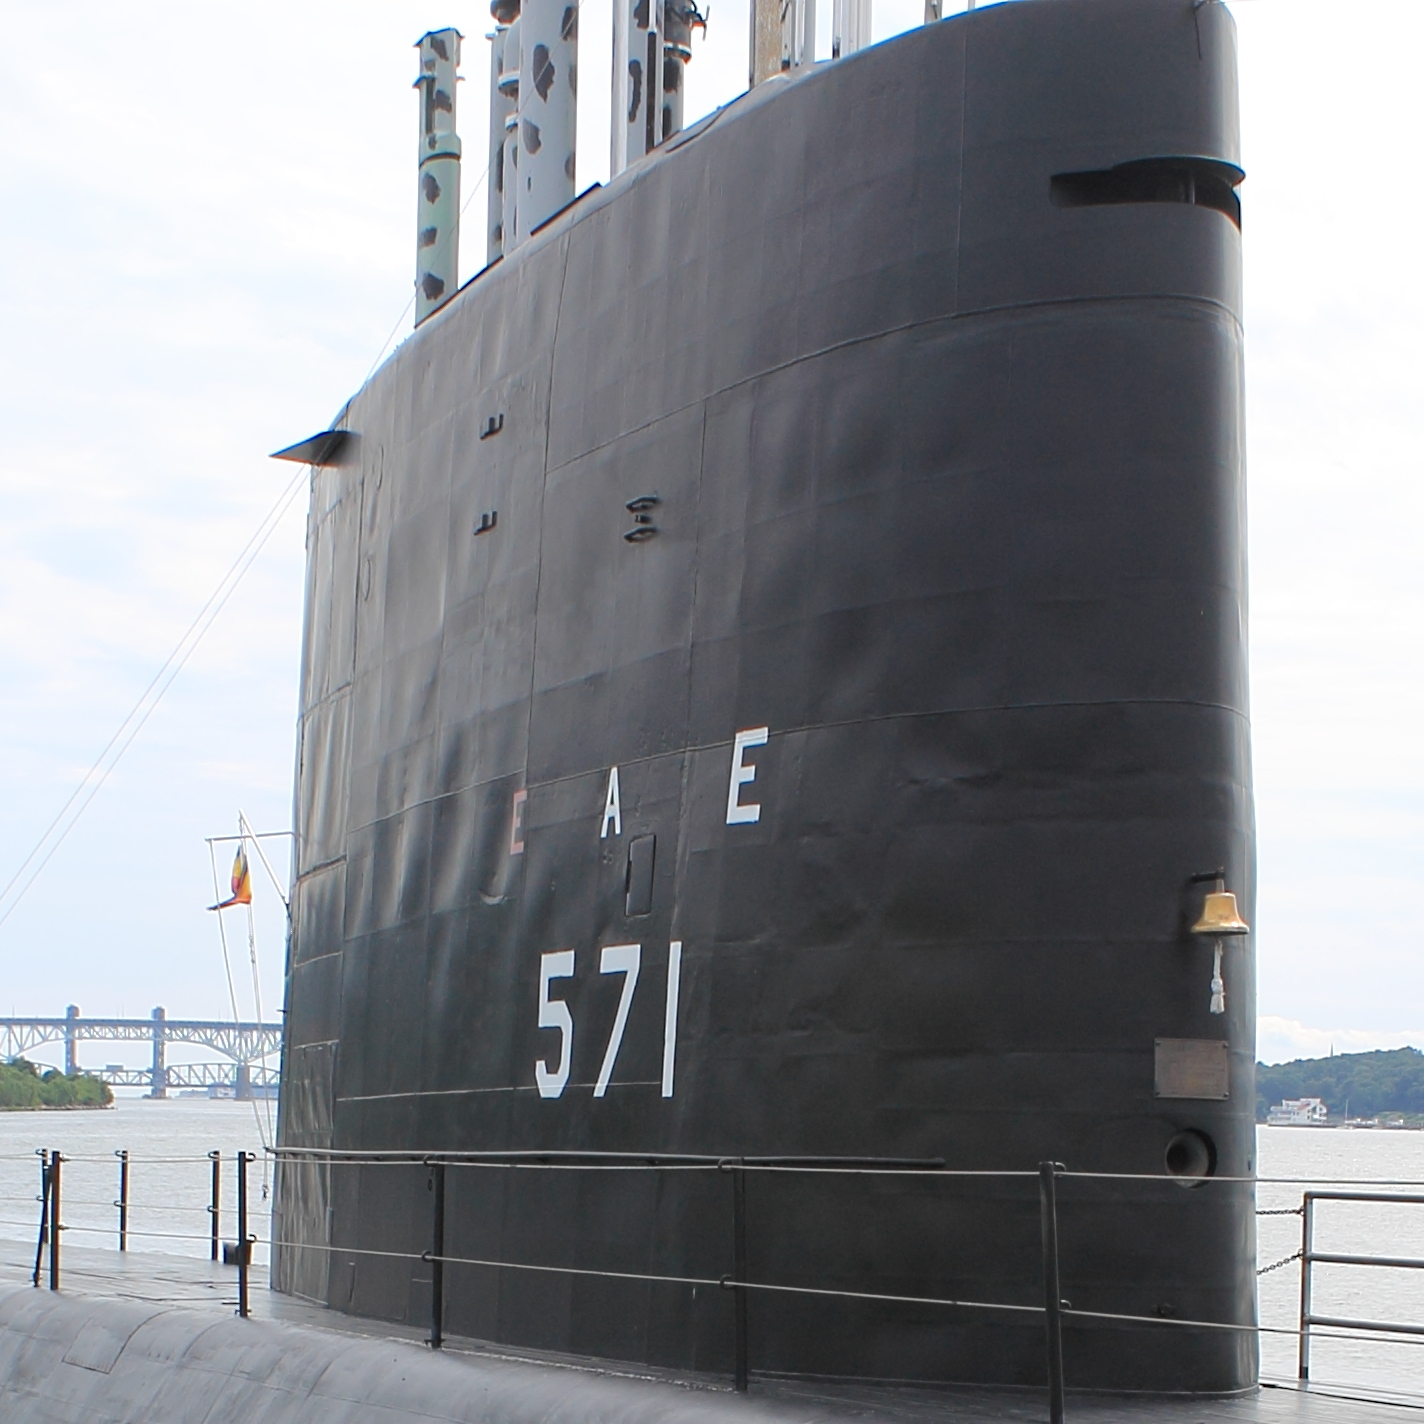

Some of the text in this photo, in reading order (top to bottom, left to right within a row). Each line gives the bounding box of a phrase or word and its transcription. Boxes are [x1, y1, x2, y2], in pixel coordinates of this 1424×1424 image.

[600, 765, 621, 838] A
[726, 726, 768, 825] E
[535, 941, 682, 1099] 571
